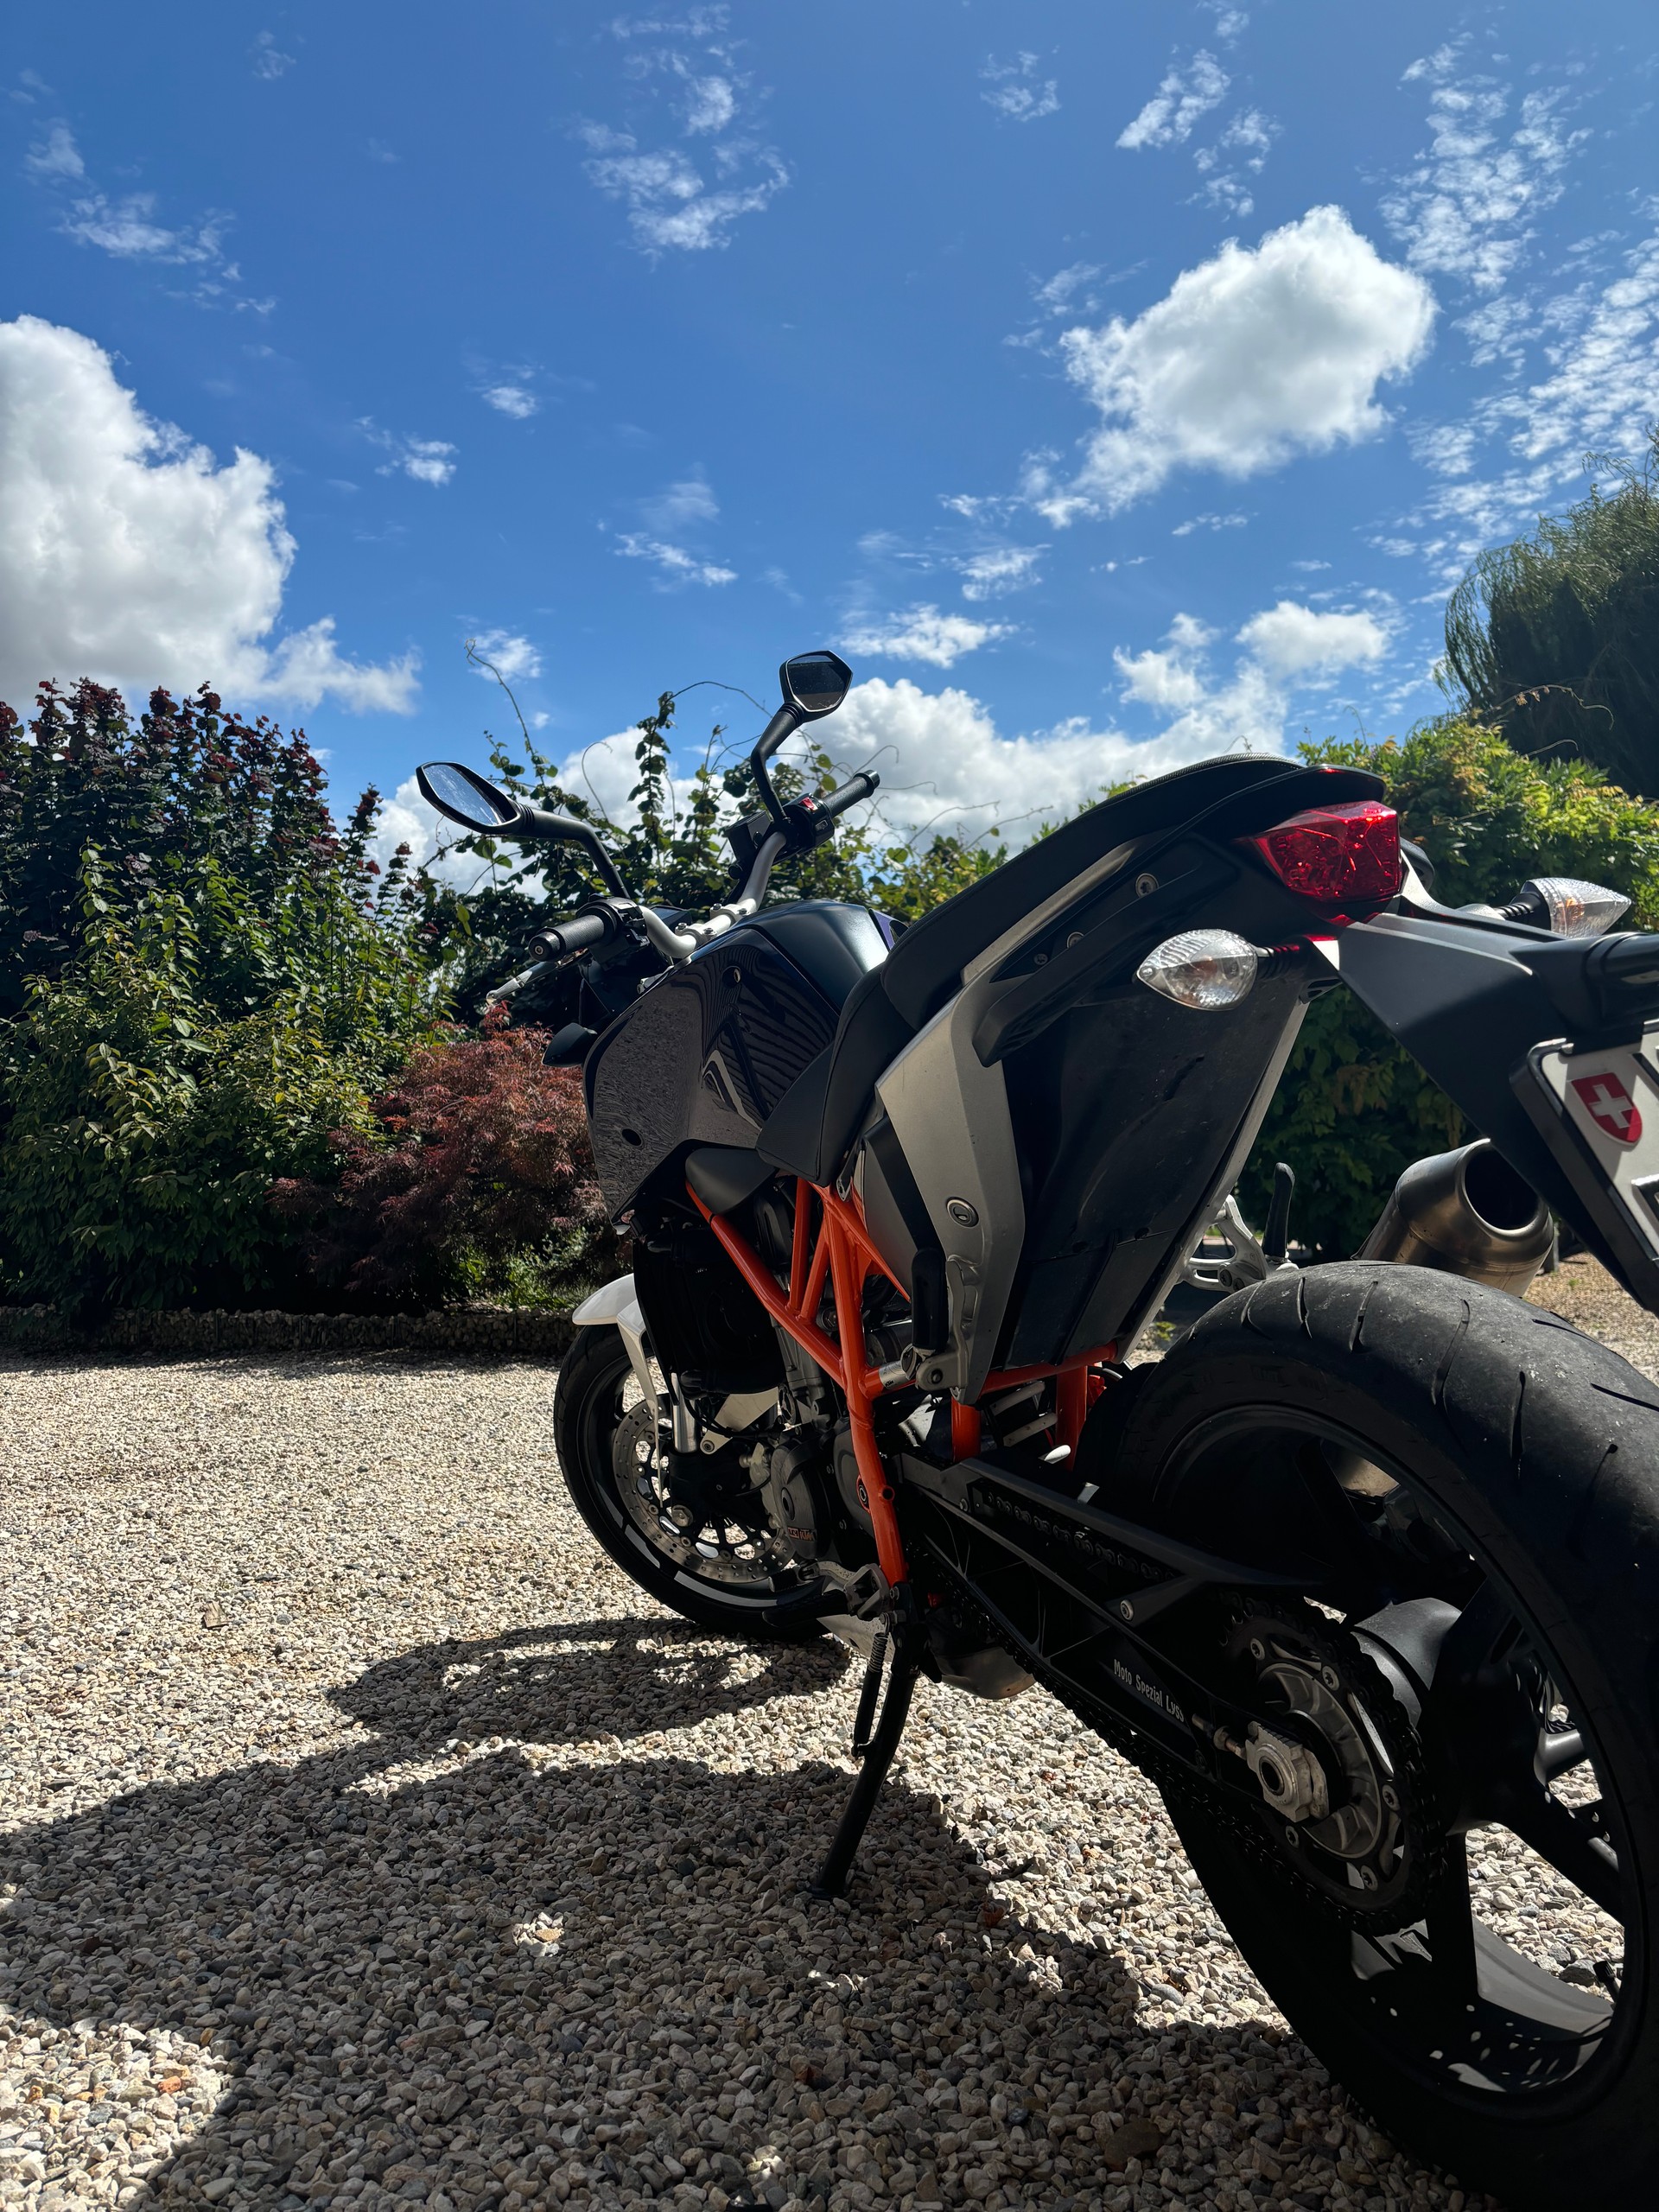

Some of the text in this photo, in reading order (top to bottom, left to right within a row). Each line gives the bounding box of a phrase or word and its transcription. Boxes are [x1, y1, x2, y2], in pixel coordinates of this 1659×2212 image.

[1113, 1658, 1185, 1723] Moto Spezial Lyss
